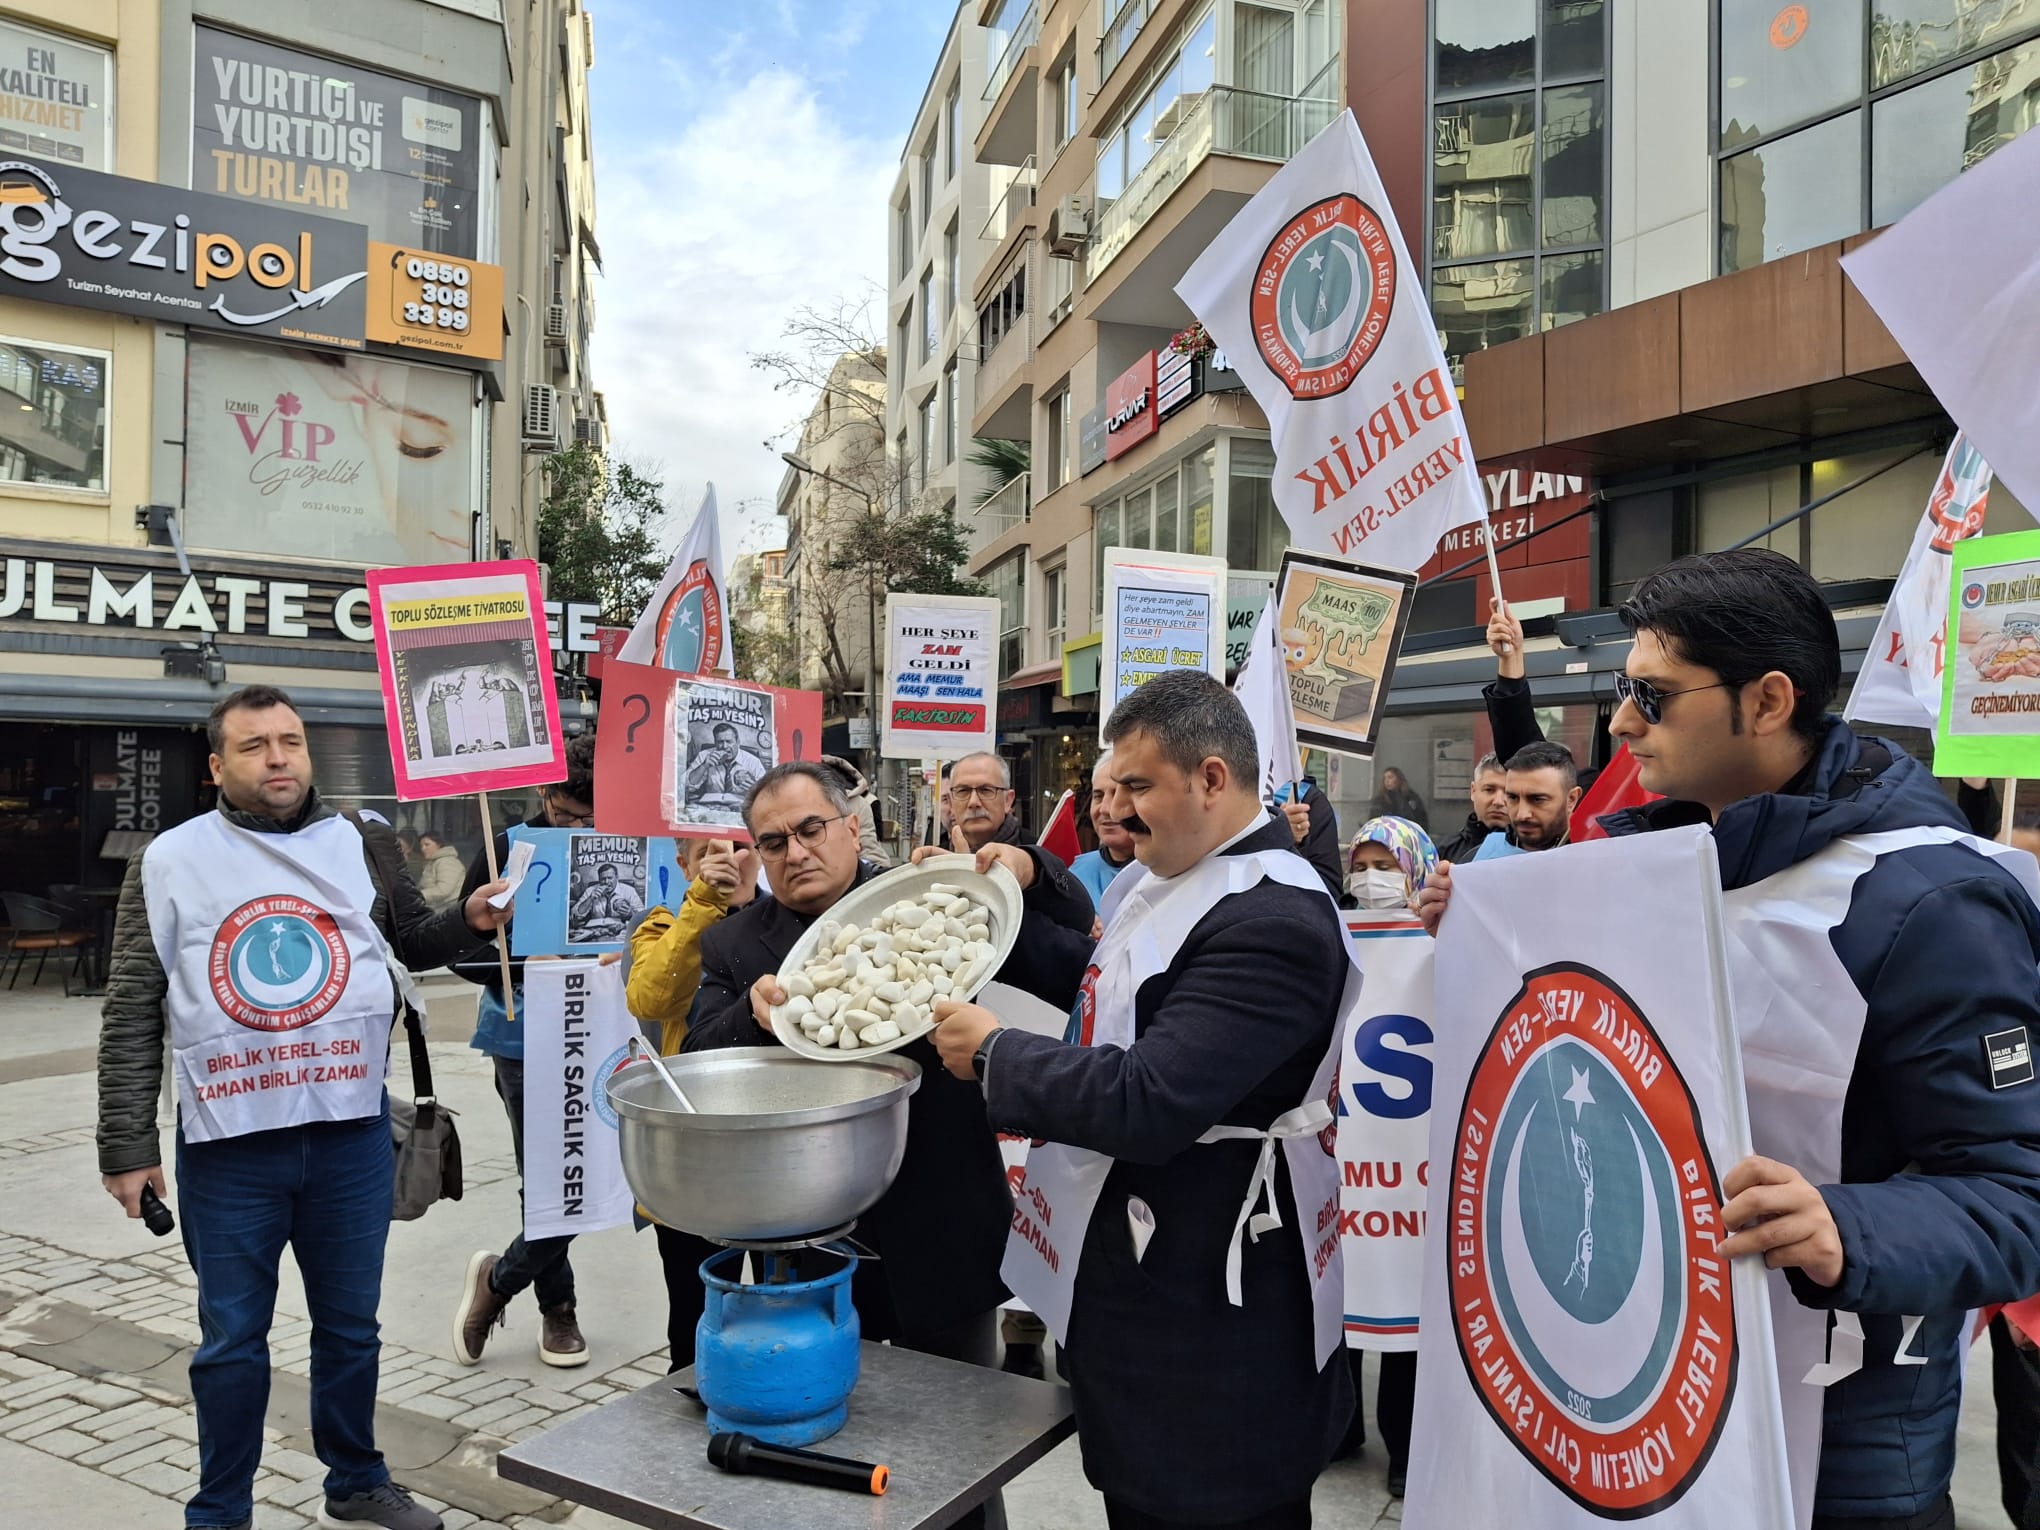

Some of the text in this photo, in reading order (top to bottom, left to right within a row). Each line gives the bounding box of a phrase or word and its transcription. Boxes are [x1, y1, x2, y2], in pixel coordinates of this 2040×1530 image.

[27, 47, 55, 75] EN
[212, 56, 383, 127] YURTİÇİ VE
[214, 104, 382, 172] YURTDIŞI
[212, 148, 349, 210] TURLAR
[0, 200, 312, 291] gezipol
[407, 258, 469, 287] 0850
[67, 278, 103, 293] Turizm
[104, 284, 152, 301] Seyahat
[422, 283, 469, 309] 308
[404, 302, 469, 331] 33 99
[400, 335, 464, 350] gezipol.com.tr
[225, 398, 259, 414] İZMİR
[250, 448, 364, 496] Güzellik
[1484, 468, 1582, 511] YLAN
[1444, 512, 1535, 553] MERKEZİ
[1124, 593, 1138, 602] Her
[1321, 594, 1357, 615] MAAŞ
[391, 609, 420, 623] TOPLU
[424, 604, 471, 621] SÖZLEŞME
[1124, 604, 1140, 613] diye
[1186, 609, 1205, 617] ZAM
[1124, 617, 1168, 626] GELMEYEN
[1364, 605, 1381, 620] 100
[902, 627, 979, 640] HER ŞEYE
[1123, 627, 1135, 635] DE
[1138, 628, 1153, 636] VAR
[921, 644, 963, 656] ZAM
[1172, 648, 1203, 666] ÜCRET
[909, 659, 972, 671] GELDİ
[897, 673, 963, 685] AMA MEMUR
[1290, 675, 1325, 696] TOPLU
[897, 685, 984, 698] MAAŞI SEN HALA
[1290, 690, 1330, 713] ZLEŞME
[688, 708, 709, 722] TAŞ
[895, 708, 977, 725] FAKİRSİN
[141, 749, 161, 831] COFFEE
[578, 838, 638, 854] MEMUR
[577, 856, 596, 866] TAŞ
[234, 902, 267, 927] BİRLİK
[214, 941, 227, 978] BİRLİK
[216, 979, 236, 1009] YEREL
[235, 1005, 280, 1027] YÖNETİM
[207, 1040, 360, 1074] BİRLİK YEREL-SEN
[197, 1078, 255, 1102] ZAMAN
[260, 1069, 309, 1090] BİRLİK
[564, 973, 590, 1217] BİRLİK SAĞLIK SEN
[1340, 1161, 1402, 1188] MU
[1020, 1173, 1051, 1228] L-SEN
[1012, 1208, 1059, 1273] ZAMANI
